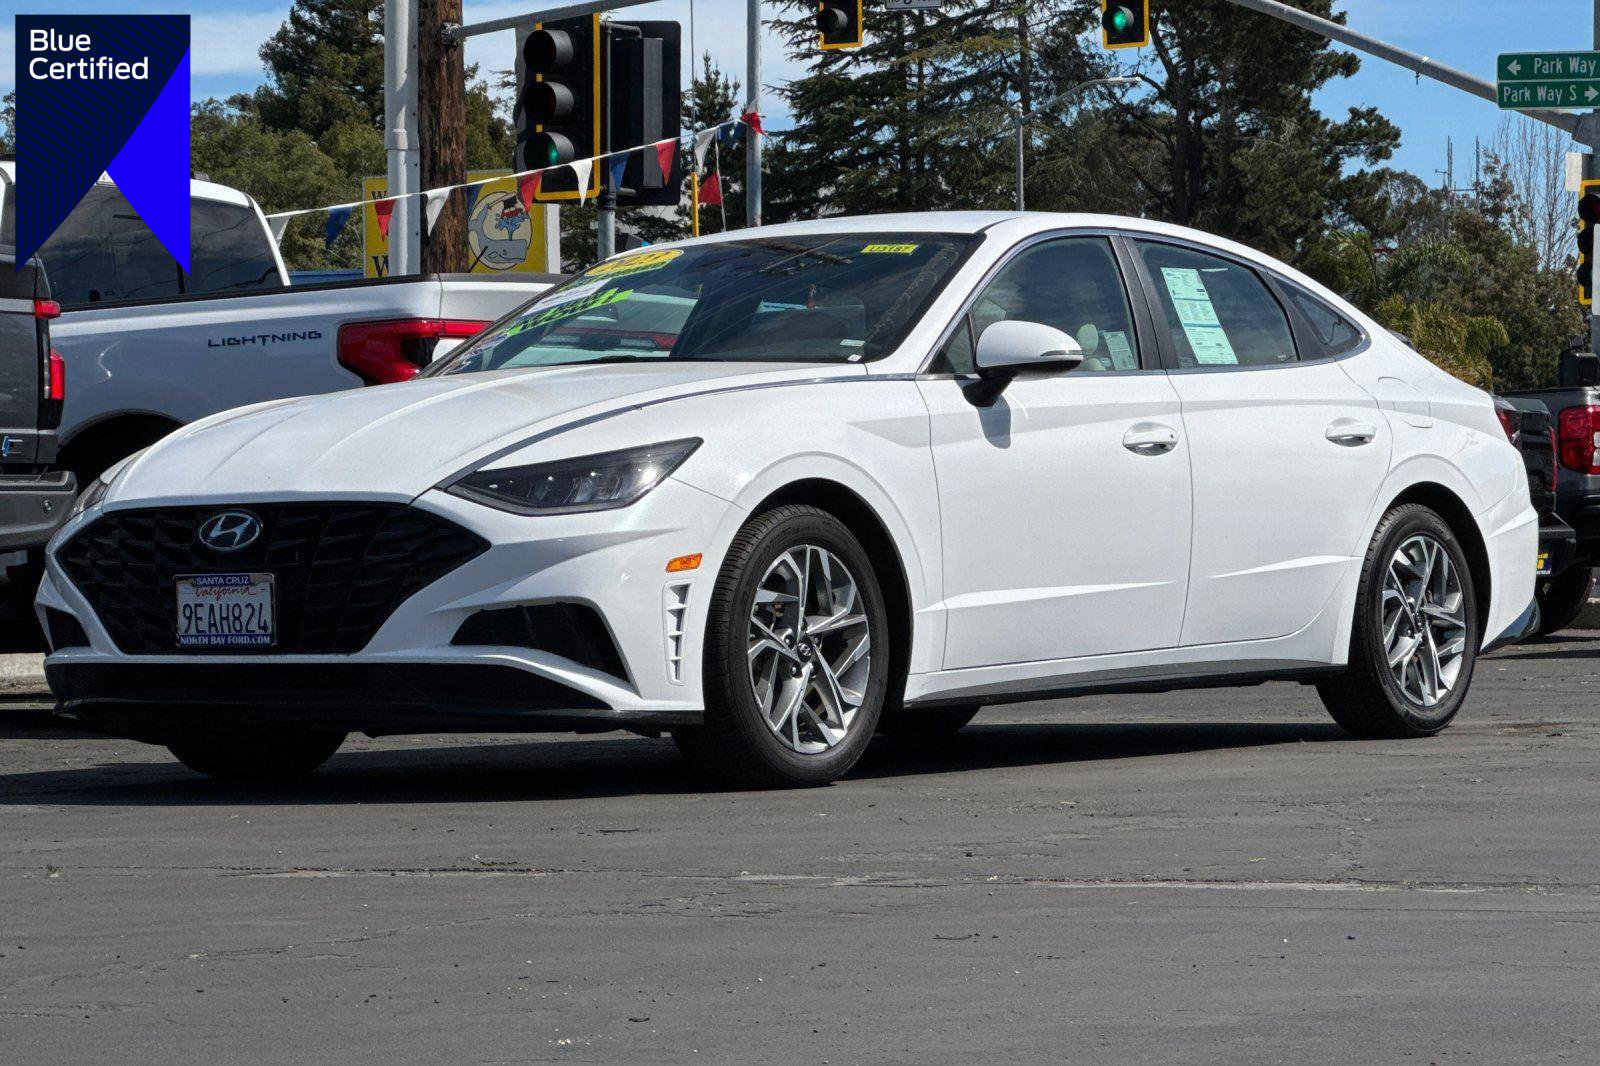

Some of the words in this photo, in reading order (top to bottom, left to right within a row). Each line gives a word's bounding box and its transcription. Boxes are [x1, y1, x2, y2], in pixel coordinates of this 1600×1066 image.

[1534, 57, 1563, 74] Park
[1569, 56, 1596, 77] Way
[1503, 86, 1531, 102] Park
[1537, 85, 1563, 105] Way
[1569, 84, 1577, 101] S
[207, 330, 322, 348] LIGHTNING
[195, 576, 225, 585] SANTA
[226, 576, 250, 585] CRUZ
[195, 586, 256, 600] California
[182, 602, 269, 634] 9EAH824
[180, 635, 209, 645] NORTH
[210, 635, 226, 645] BAY
[227, 635, 271, 645] FORD.COM
